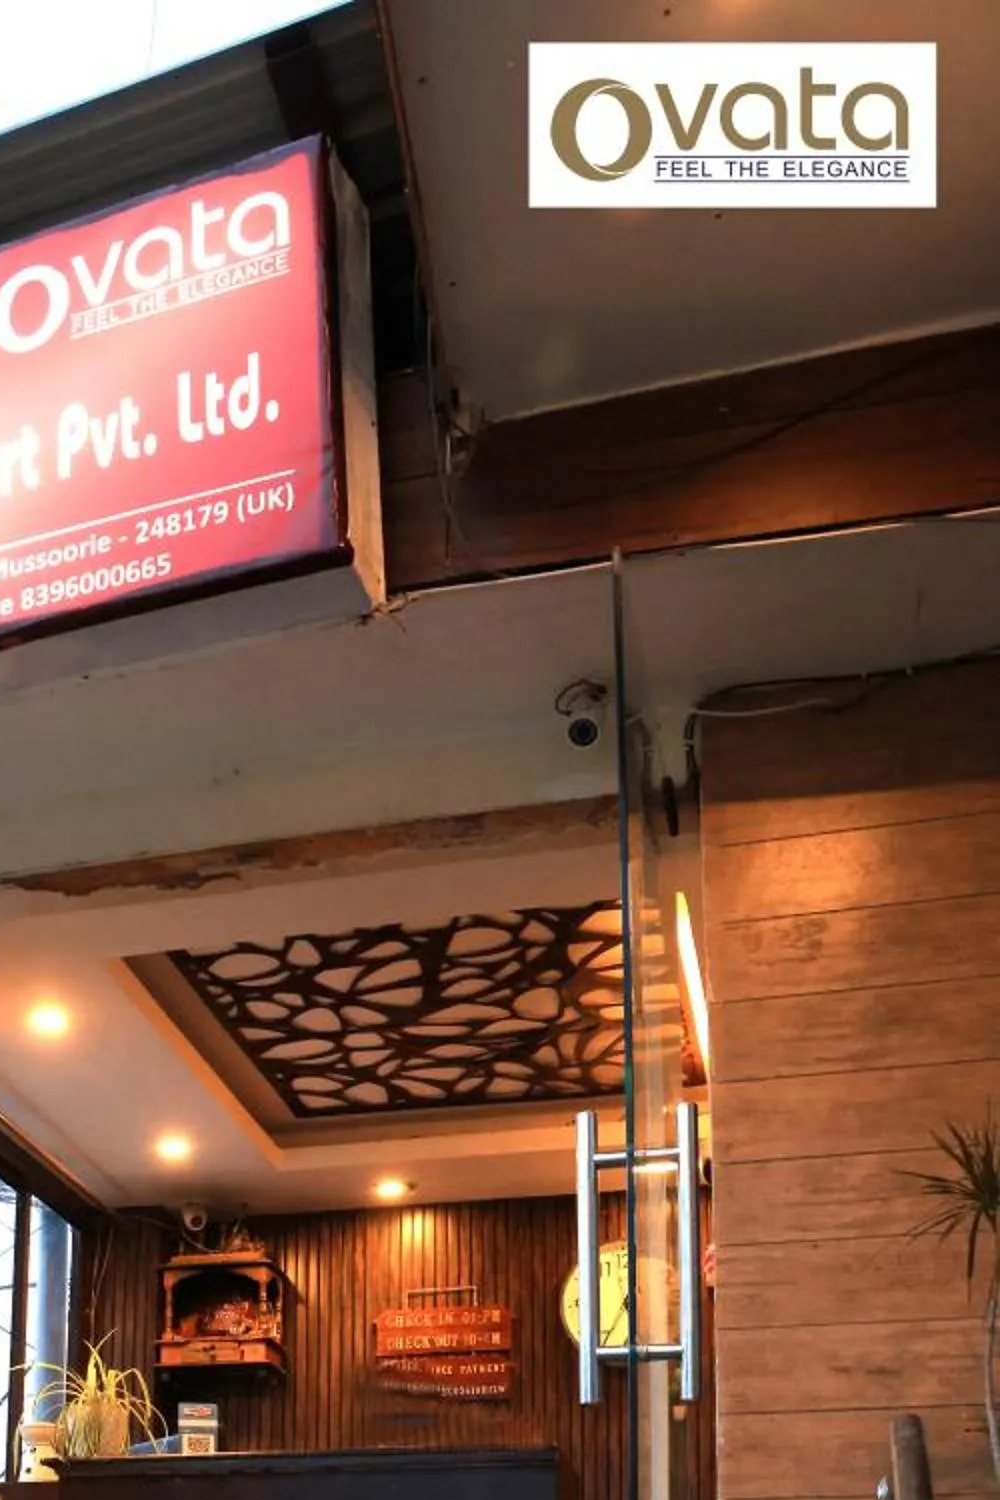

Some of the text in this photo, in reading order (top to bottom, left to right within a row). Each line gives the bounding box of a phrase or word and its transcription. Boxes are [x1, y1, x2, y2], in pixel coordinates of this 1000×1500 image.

[71, 253, 289, 334] FEEL THE ELEGANCE
[57, 395, 157, 480] Pvt.
[177, 352, 280, 443] Ltd.
[135, 501, 229, 545] 248179
[236, 482, 295, 523] (UK)
[20, 553, 172, 611] 8396000665
